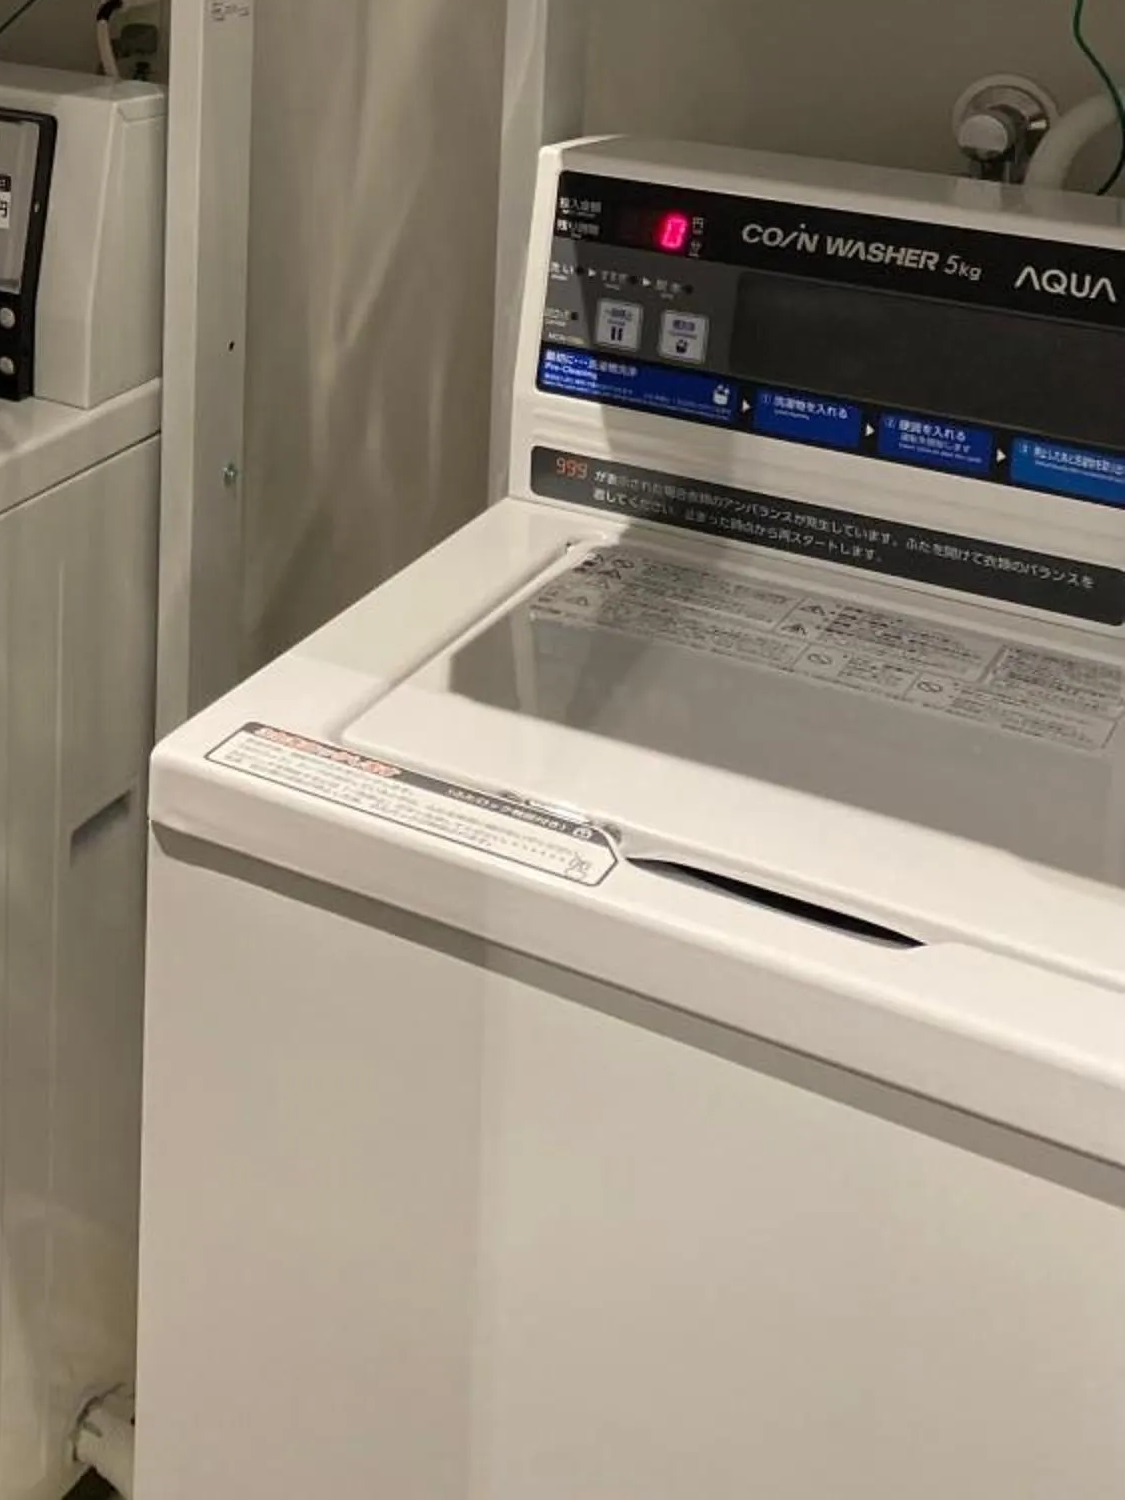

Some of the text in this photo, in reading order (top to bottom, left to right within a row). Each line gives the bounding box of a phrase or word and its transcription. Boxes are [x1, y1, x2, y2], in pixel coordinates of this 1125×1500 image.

[660, 216, 688, 249] 0
[824, 234, 940, 271] WASHER
[942, 254, 983, 281] 5kg
[1013, 264, 1117, 303] AQUA
[556, 457, 589, 480] 999
